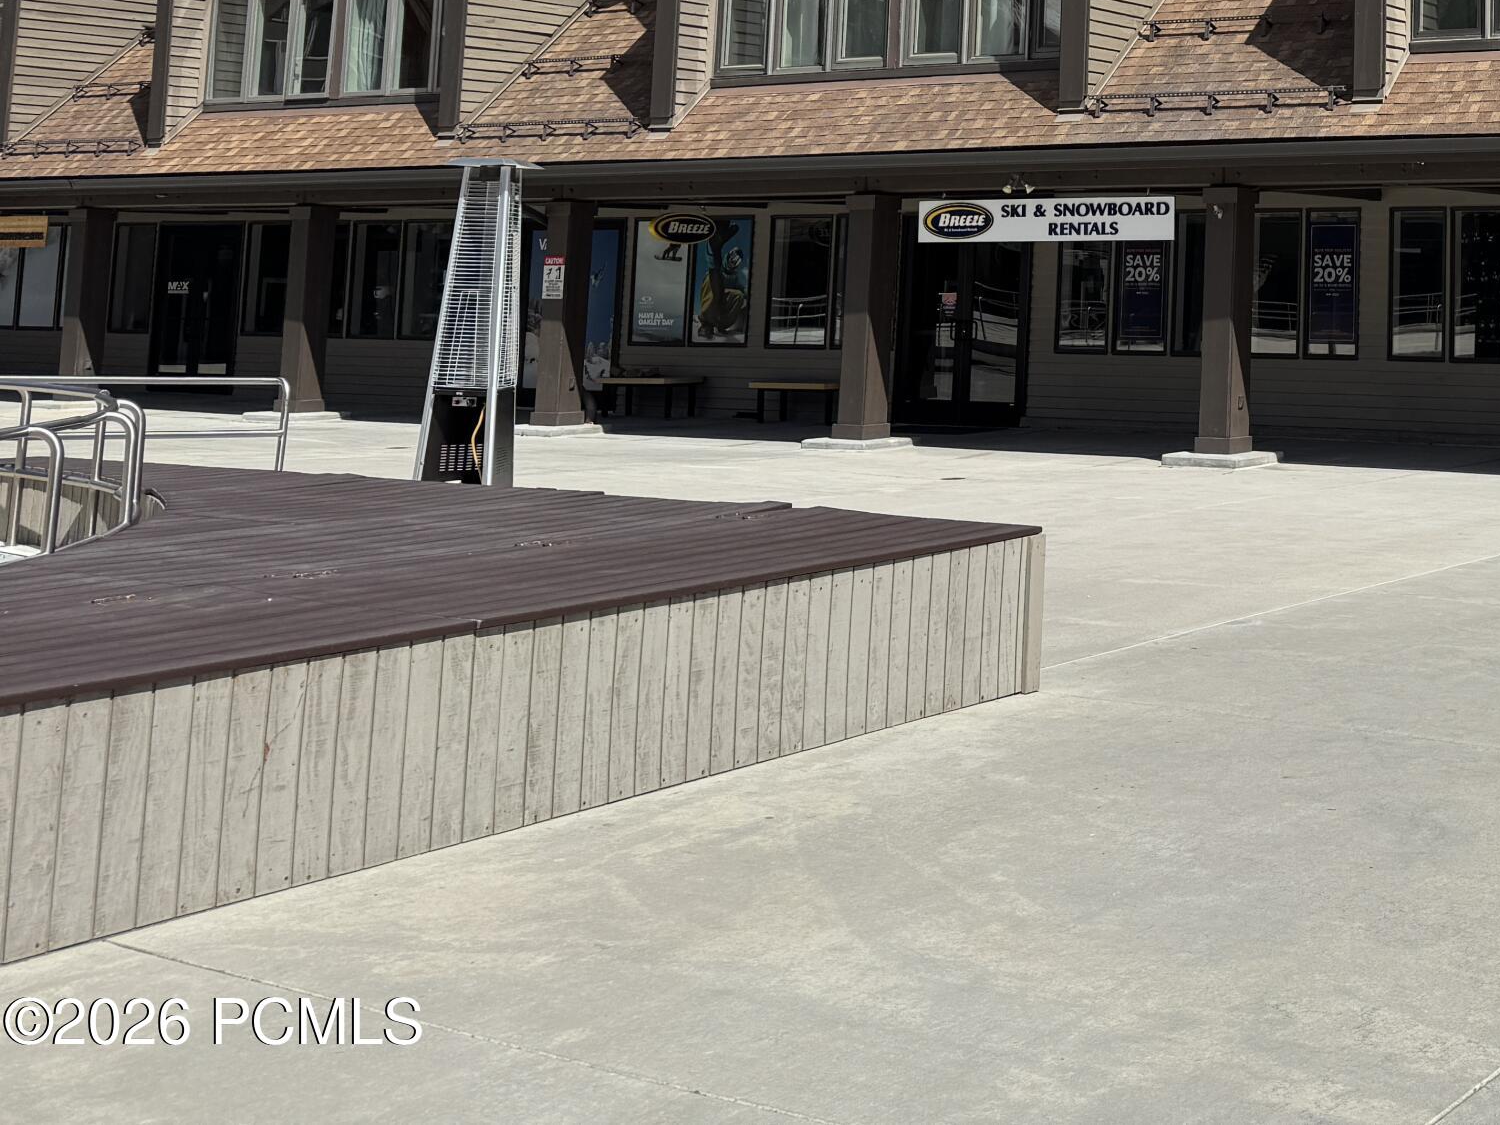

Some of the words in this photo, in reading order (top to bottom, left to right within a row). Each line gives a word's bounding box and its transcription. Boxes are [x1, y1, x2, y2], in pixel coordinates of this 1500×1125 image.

[1001, 204, 1027, 218] SKI
[1033, 204, 1047, 217] &
[1053, 201, 1170, 217] SNOWBOARD
[939, 213, 986, 227] BREEZE
[668, 221, 711, 234] BREEZE
[1048, 221, 1119, 236] RENTALS
[1125, 254, 1161, 266] SAVE
[1313, 254, 1352, 266] SAVE
[1125, 267, 1161, 282] 20%
[1313, 267, 1352, 282] 20%
